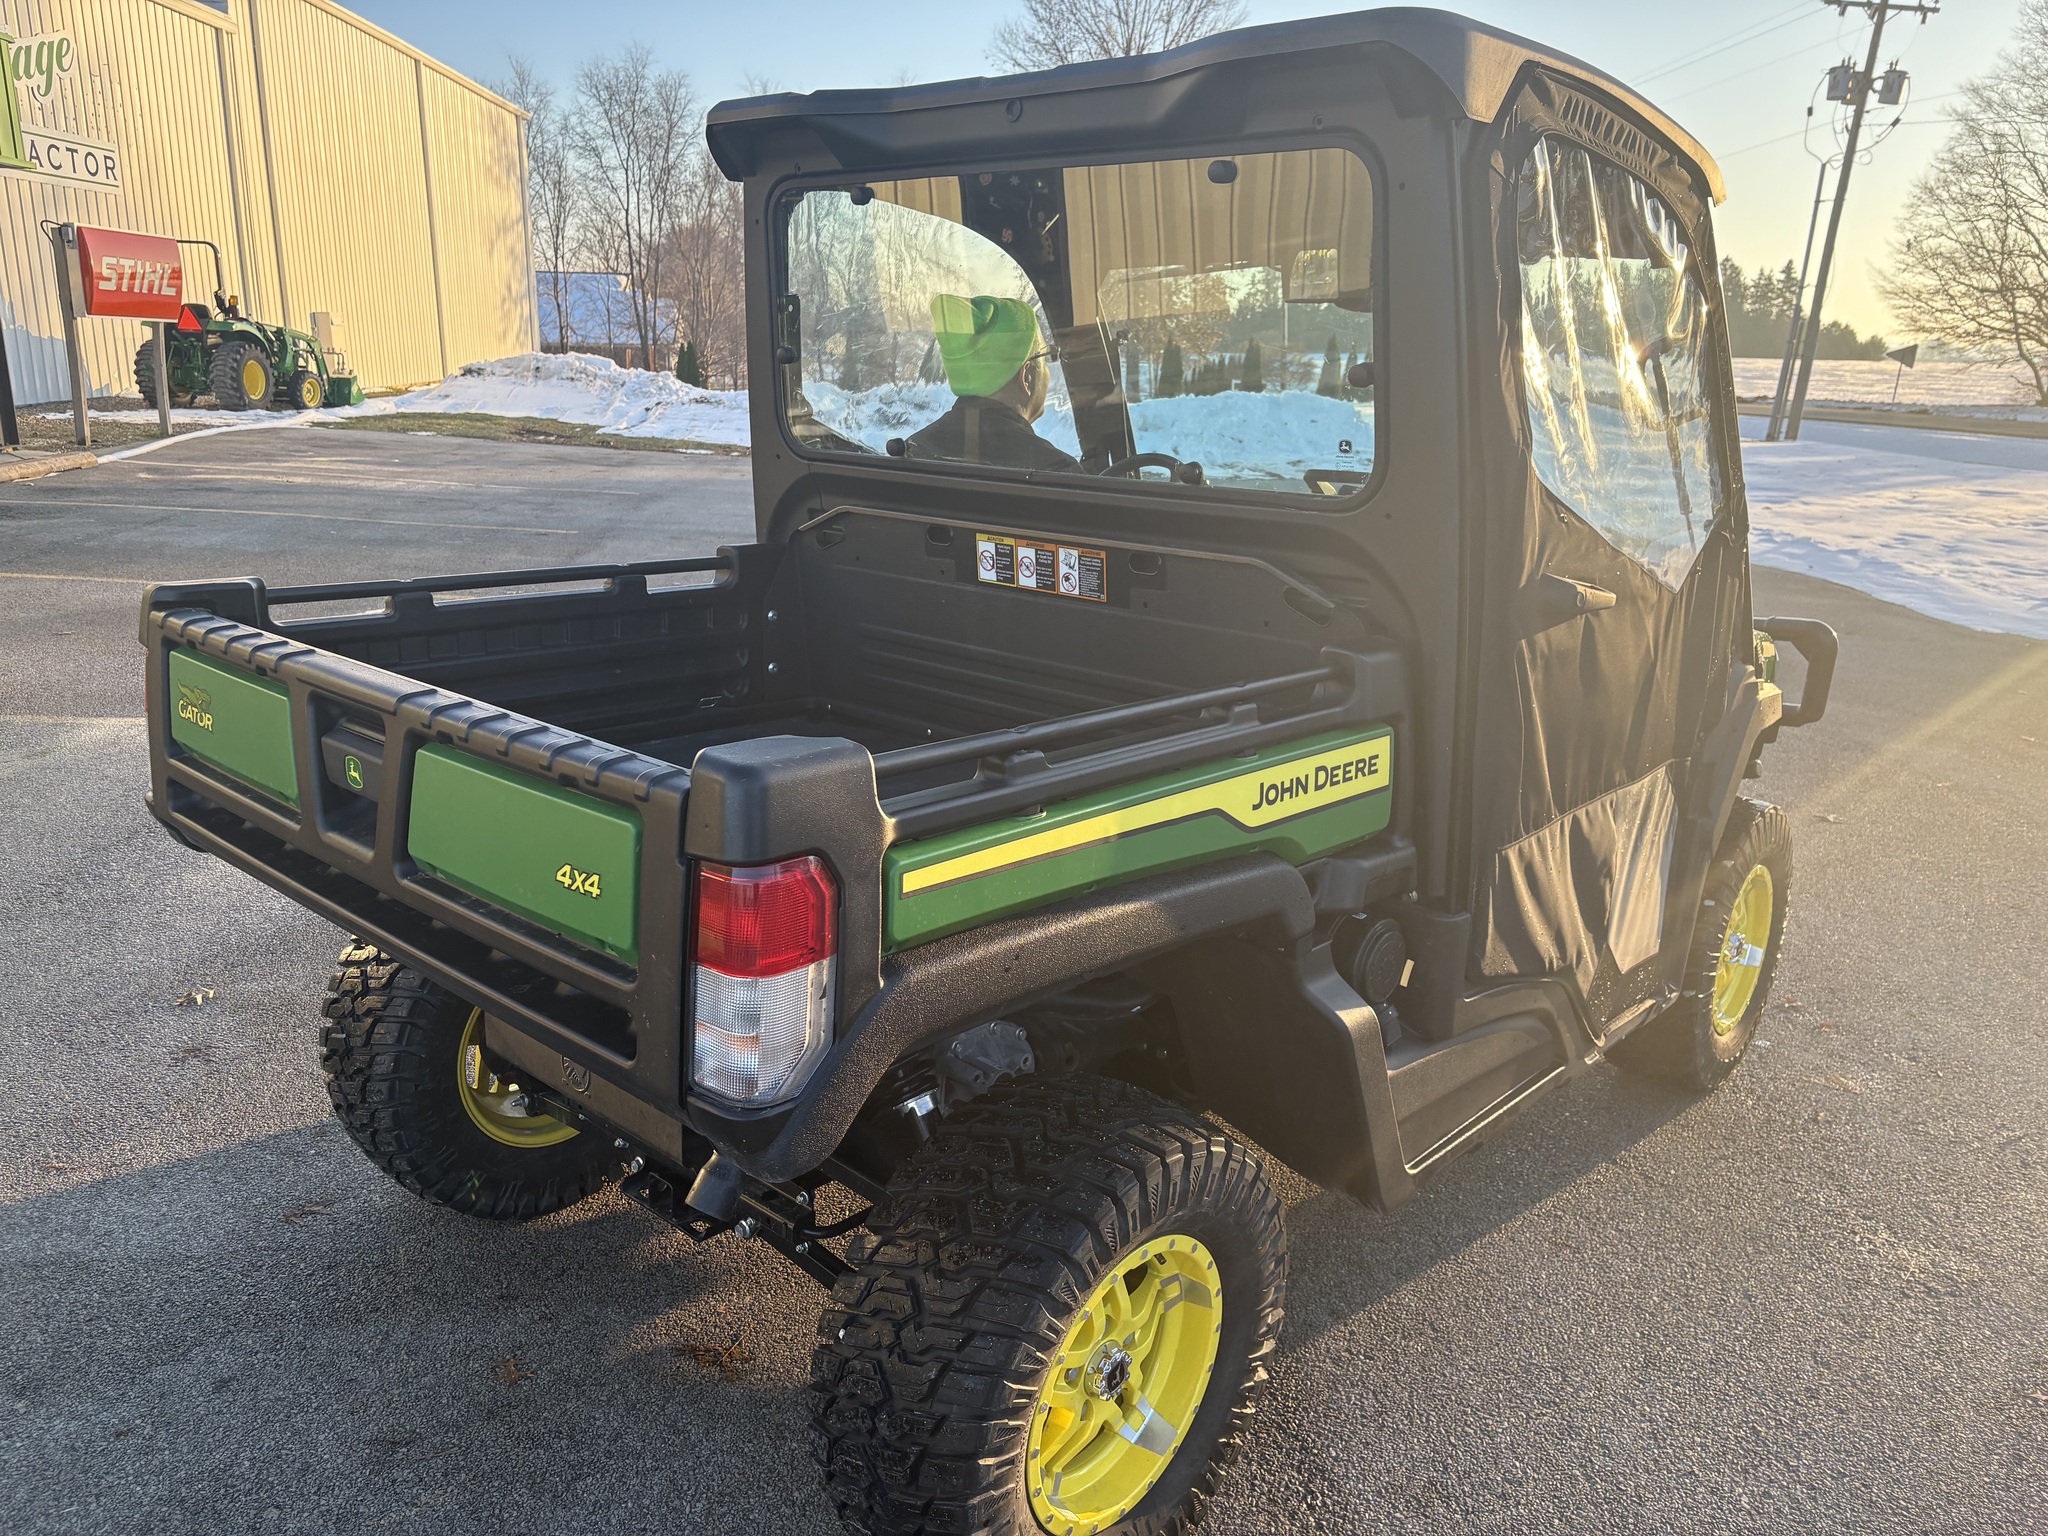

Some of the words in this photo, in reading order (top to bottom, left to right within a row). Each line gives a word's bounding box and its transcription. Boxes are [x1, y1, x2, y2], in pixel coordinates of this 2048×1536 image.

[98, 256, 177, 296] STIHL
[178, 699, 213, 732] GATOR
[1252, 774, 1309, 811] JOHN
[1314, 754, 1379, 792] DEERE
